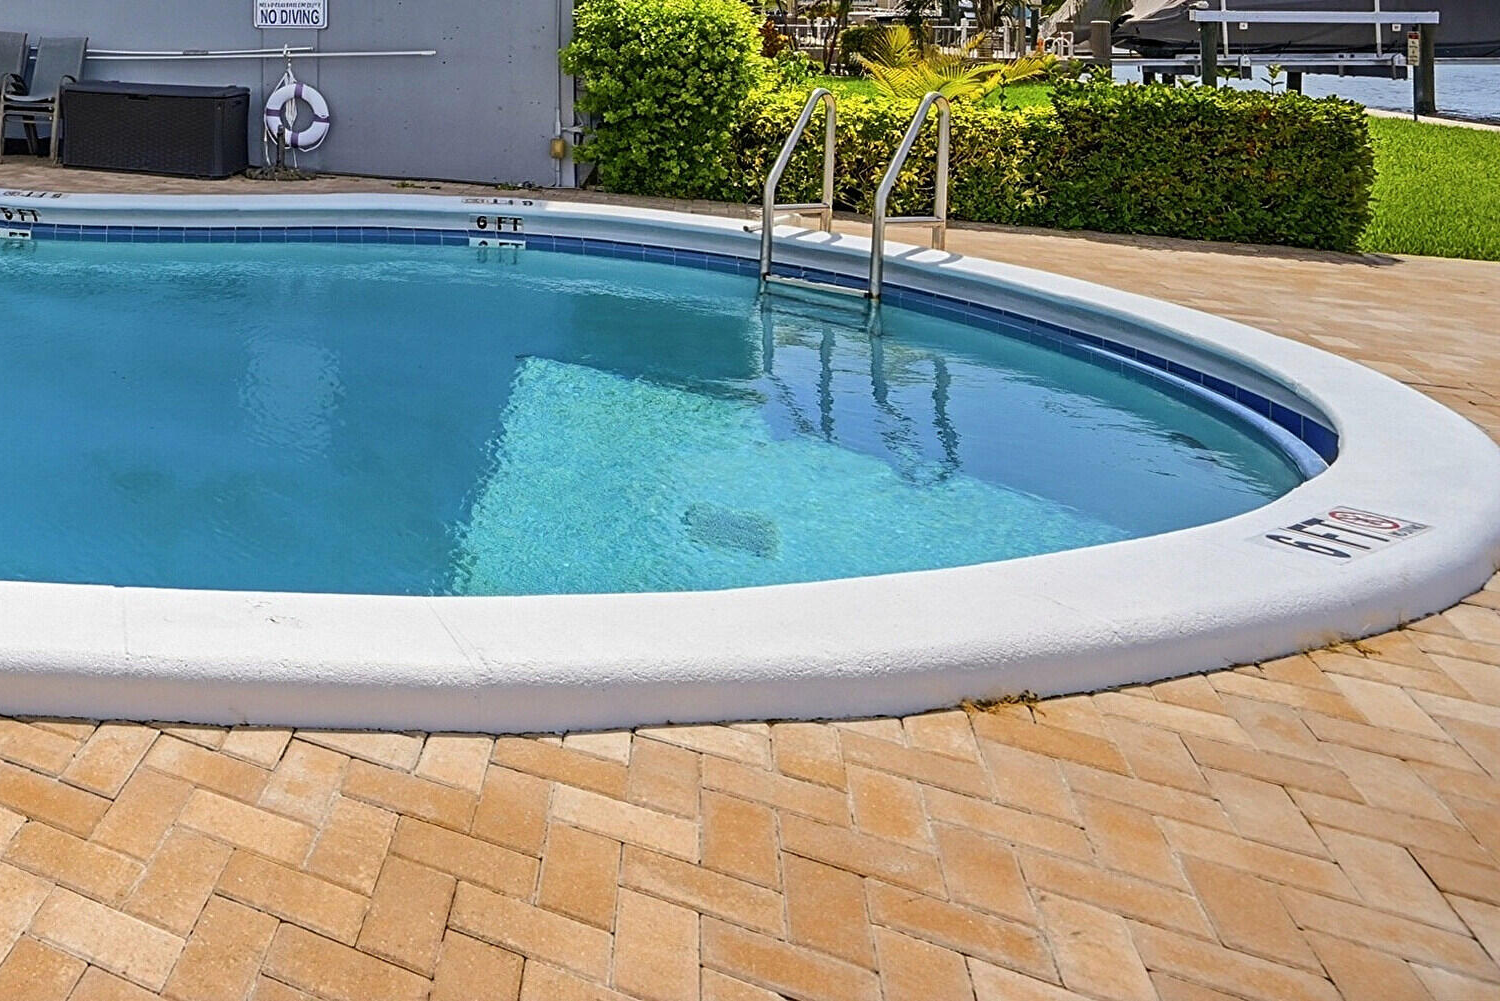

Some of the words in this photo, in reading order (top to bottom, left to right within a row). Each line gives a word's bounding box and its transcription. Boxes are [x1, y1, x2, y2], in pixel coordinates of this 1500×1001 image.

[261, 9, 277, 24] NO
[280, 9, 320, 25] DIVING
[0, 207, 13, 220] 5
[16, 208, 39, 222] FT
[476, 215, 487, 229] 6
[497, 216, 523, 231] FT
[1286, 517, 1390, 550] FT
